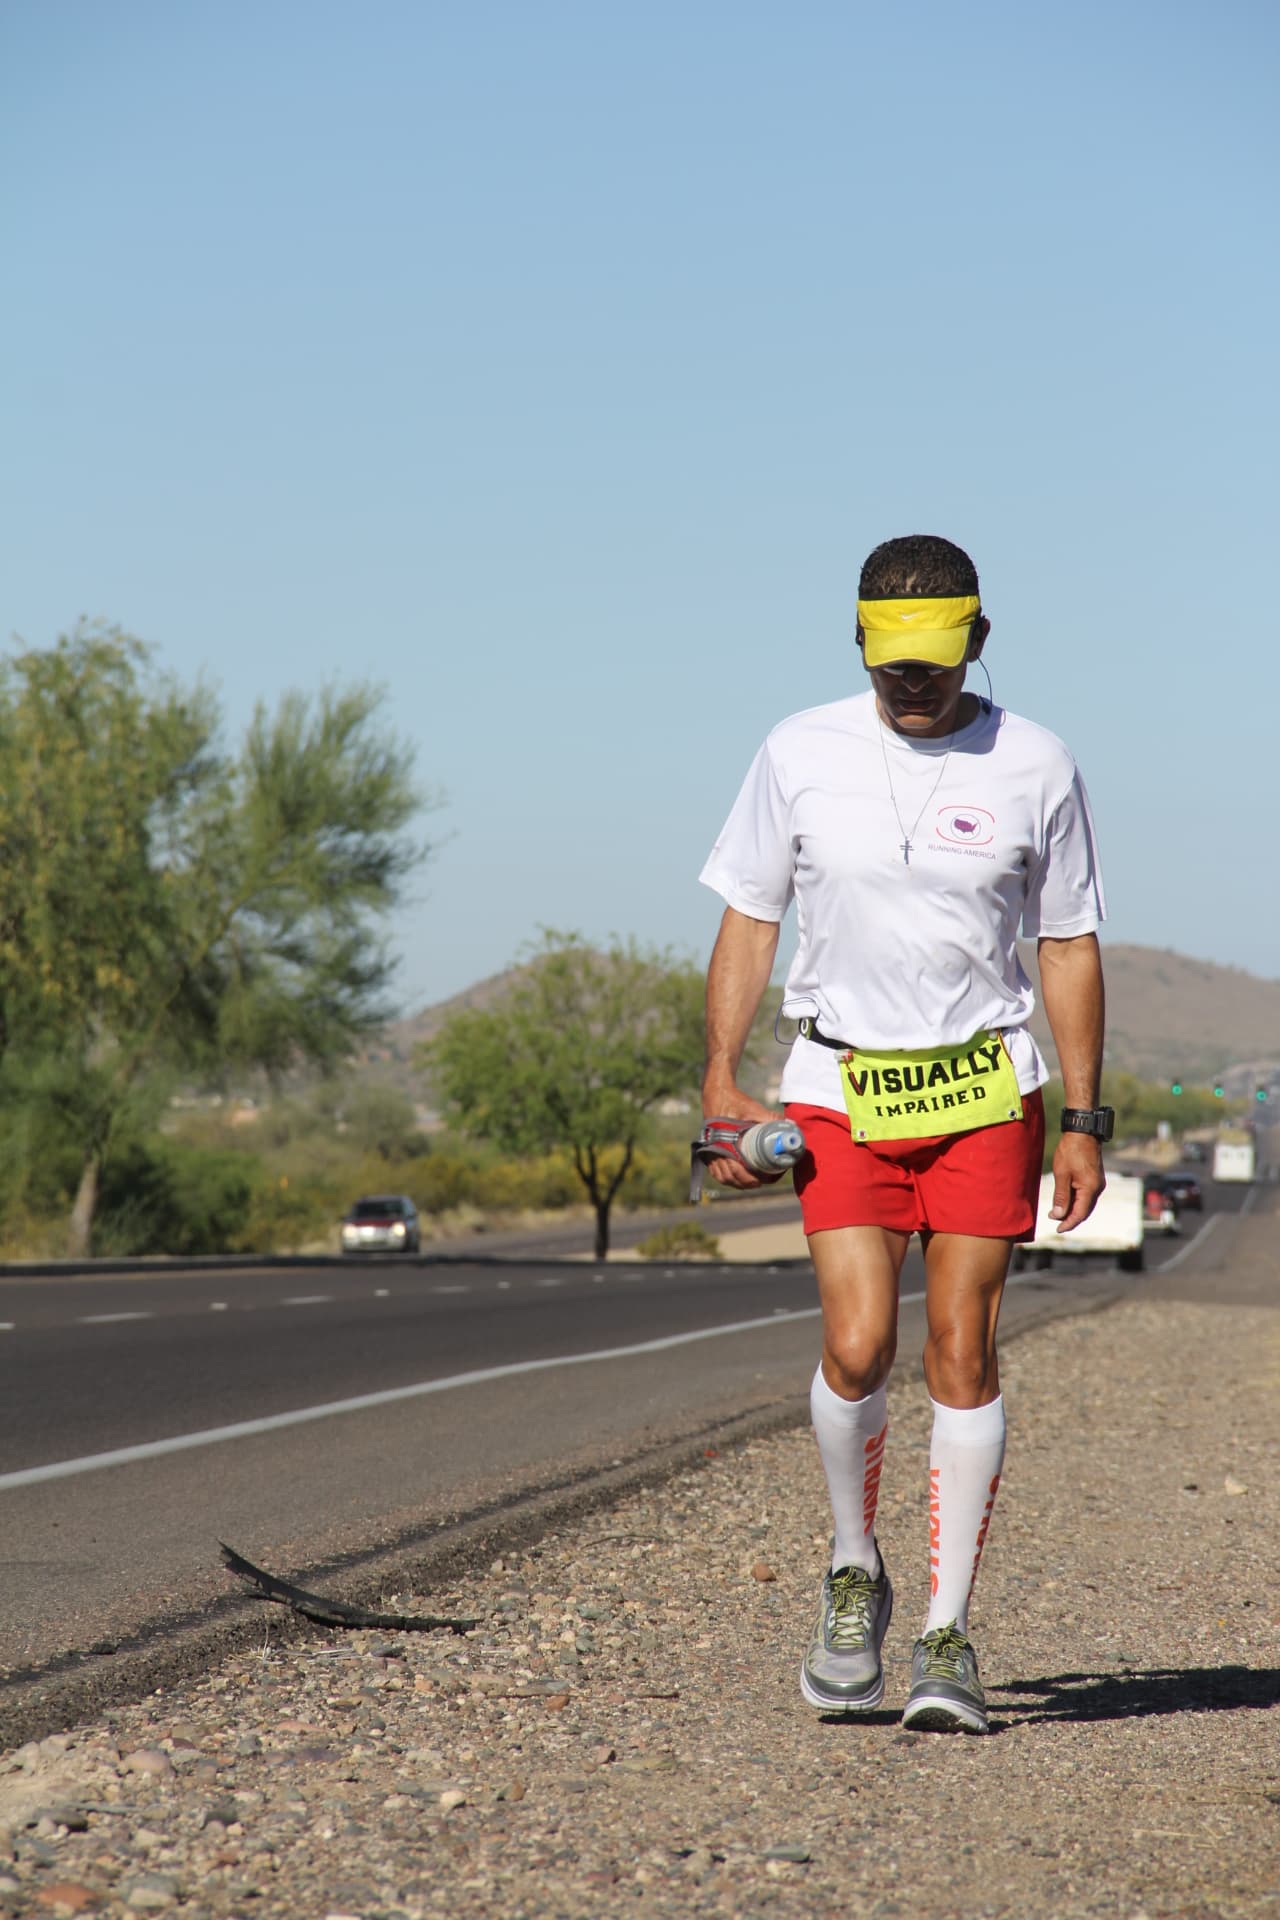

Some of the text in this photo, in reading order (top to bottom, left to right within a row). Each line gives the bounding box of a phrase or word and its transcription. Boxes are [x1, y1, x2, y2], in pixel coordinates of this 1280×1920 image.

[927, 843, 997, 860] RUNNING AMERICA
[848, 1043, 1001, 1096] VISUALLY
[875, 1086, 986, 1117] IMPAIRED
